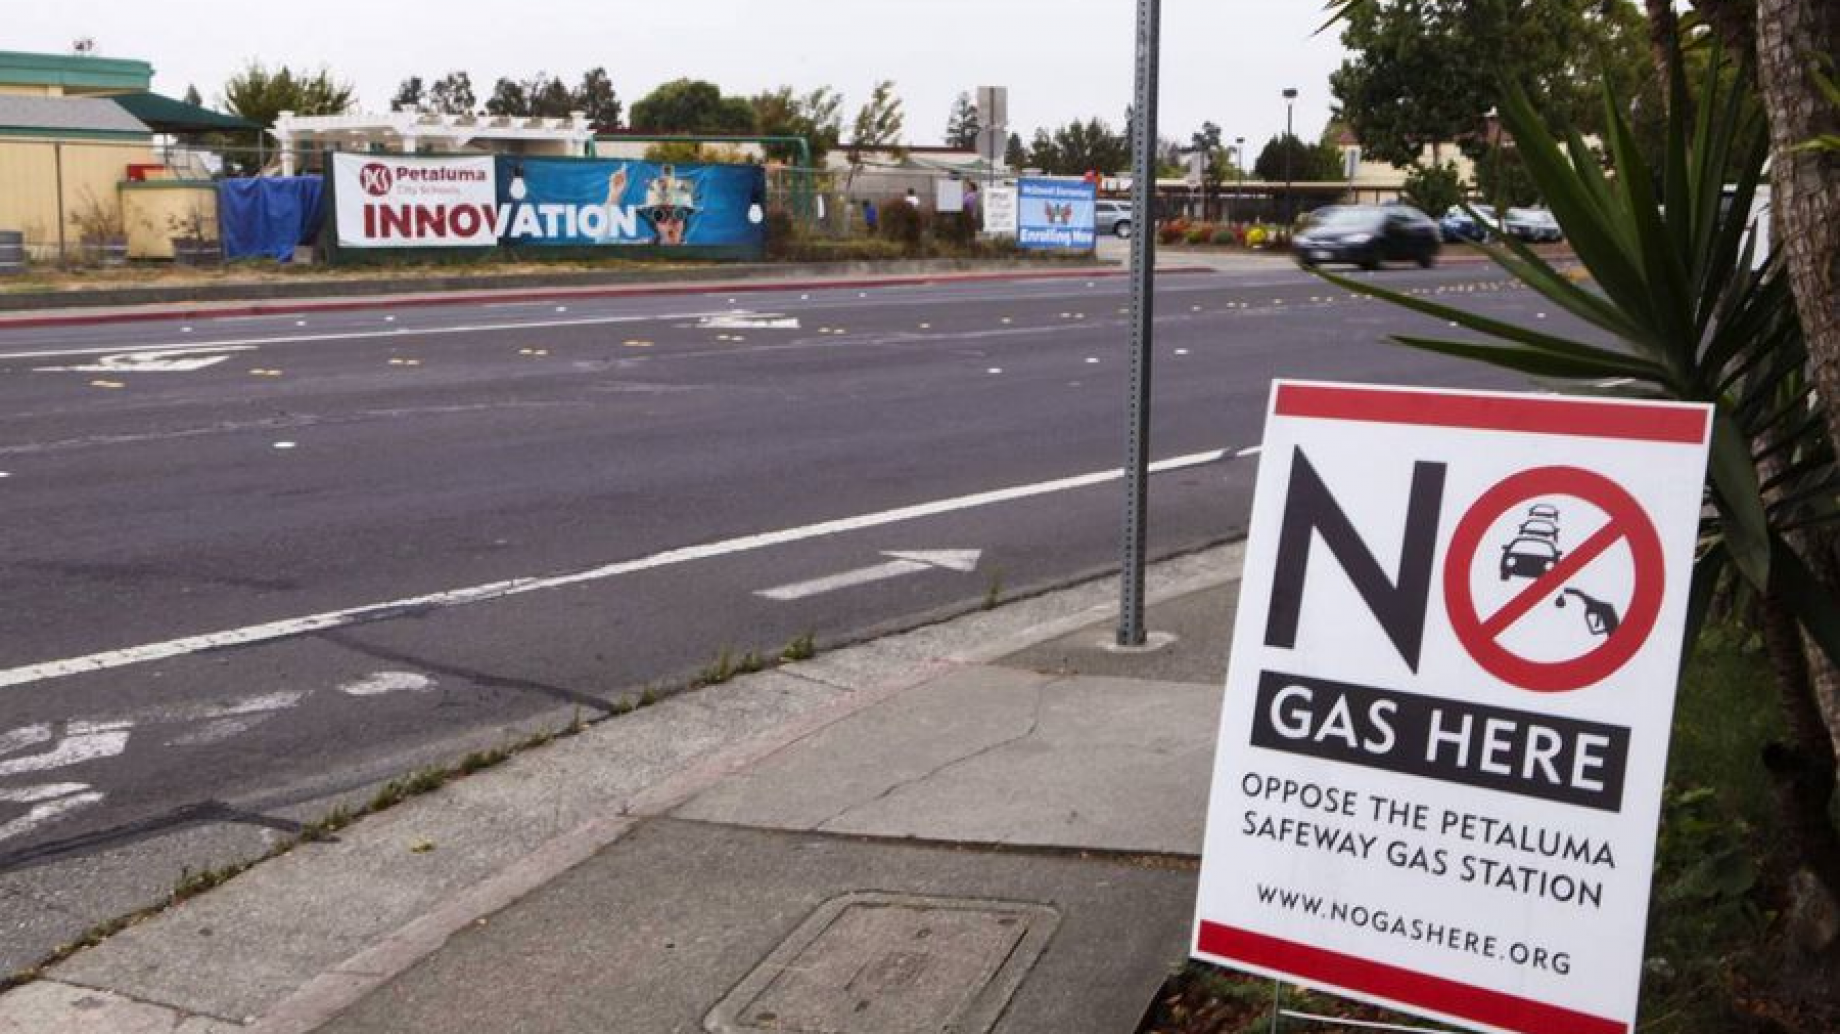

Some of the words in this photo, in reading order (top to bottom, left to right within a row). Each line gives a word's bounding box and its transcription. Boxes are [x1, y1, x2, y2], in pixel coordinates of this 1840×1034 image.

[396, 166, 486, 181] Petaluma
[364, 203, 638, 239] INNOVATION
[1020, 229, 1071, 247] Enrolling
[1073, 230, 1094, 243] Now
[1267, 685, 1400, 756] GAS
[1424, 708, 1613, 791] HERE
[1243, 774, 1356, 817] OPPOSE
[1370, 796, 1427, 829] THE
[1438, 810, 1617, 869] PETALUMA
[1243, 811, 1378, 858] SAFEWAY
[1388, 841, 1446, 875] GAS
[1462, 857, 1604, 907] STATION
[1254, 883, 1574, 976] WWW.NOGASHERE.ORG
